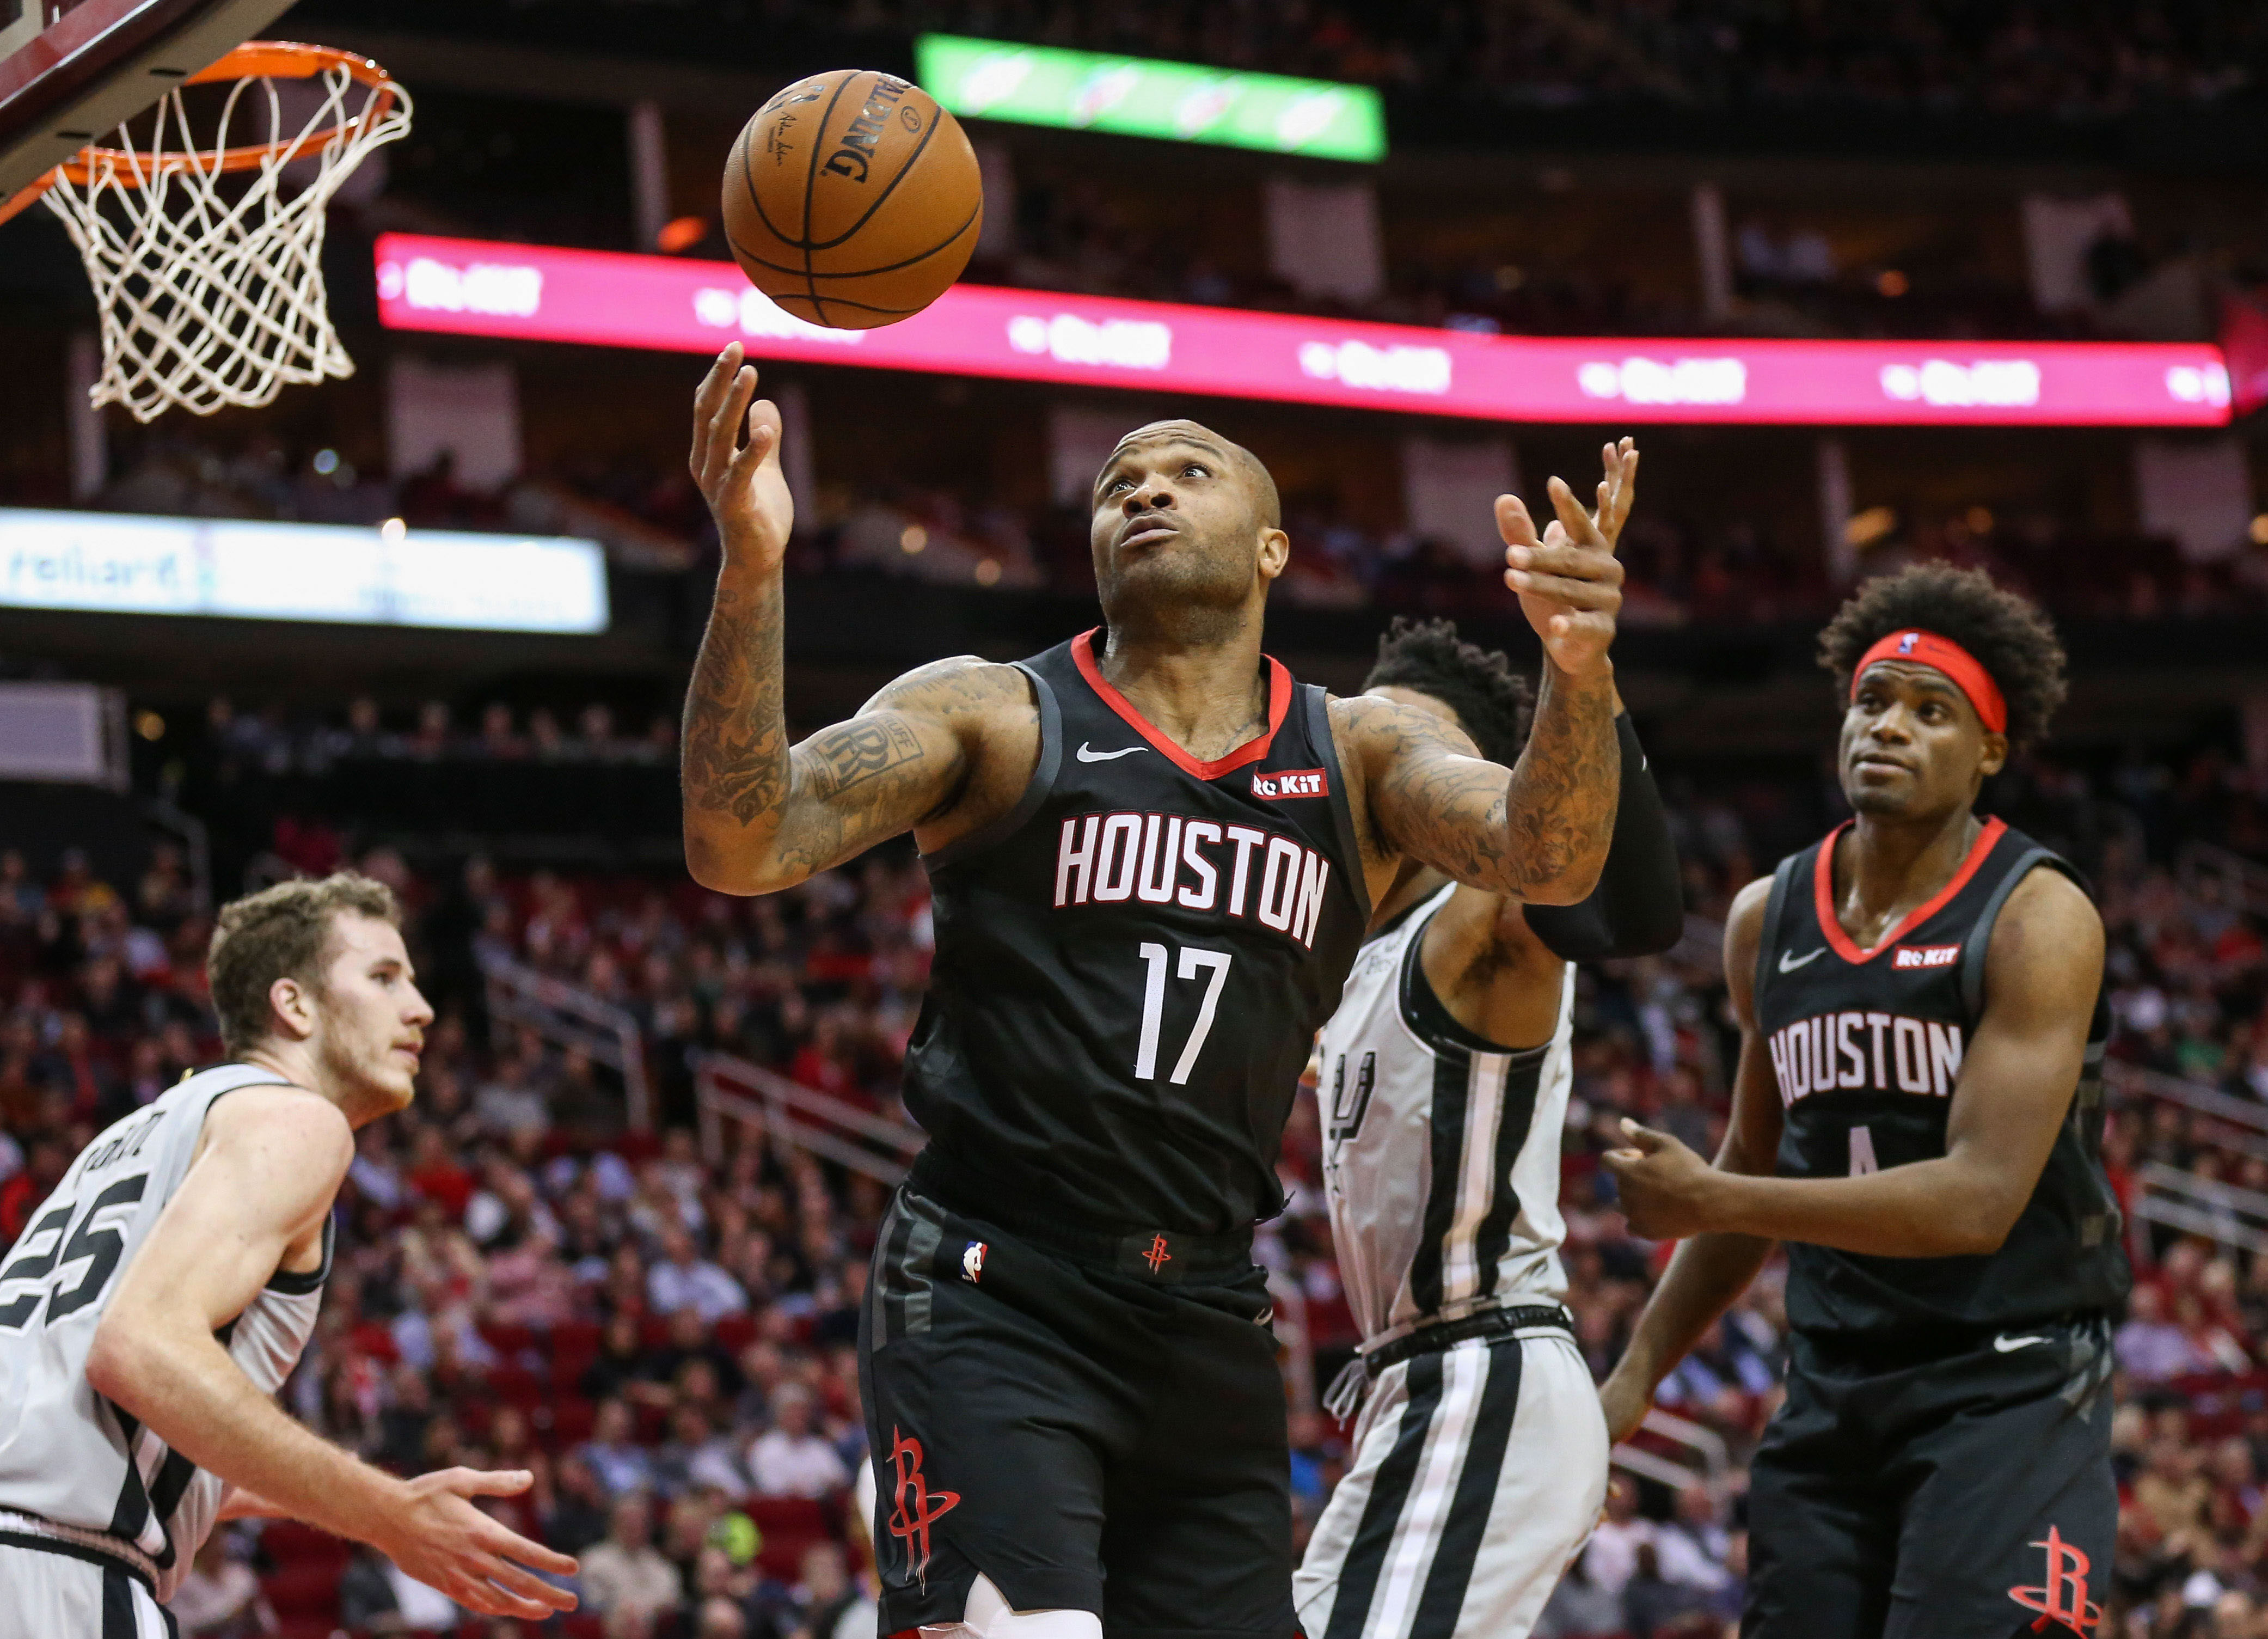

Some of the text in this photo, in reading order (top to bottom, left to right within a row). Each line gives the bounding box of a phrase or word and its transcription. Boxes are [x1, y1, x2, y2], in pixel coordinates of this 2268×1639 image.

[824, 77, 905, 184] ALDING
[1053, 813, 1329, 951] HOUSTON
[1135, 942, 1232, 1085] 17
[1769, 1011, 1963, 1109] HOUSTON
[0, 1172, 149, 1329] 25
